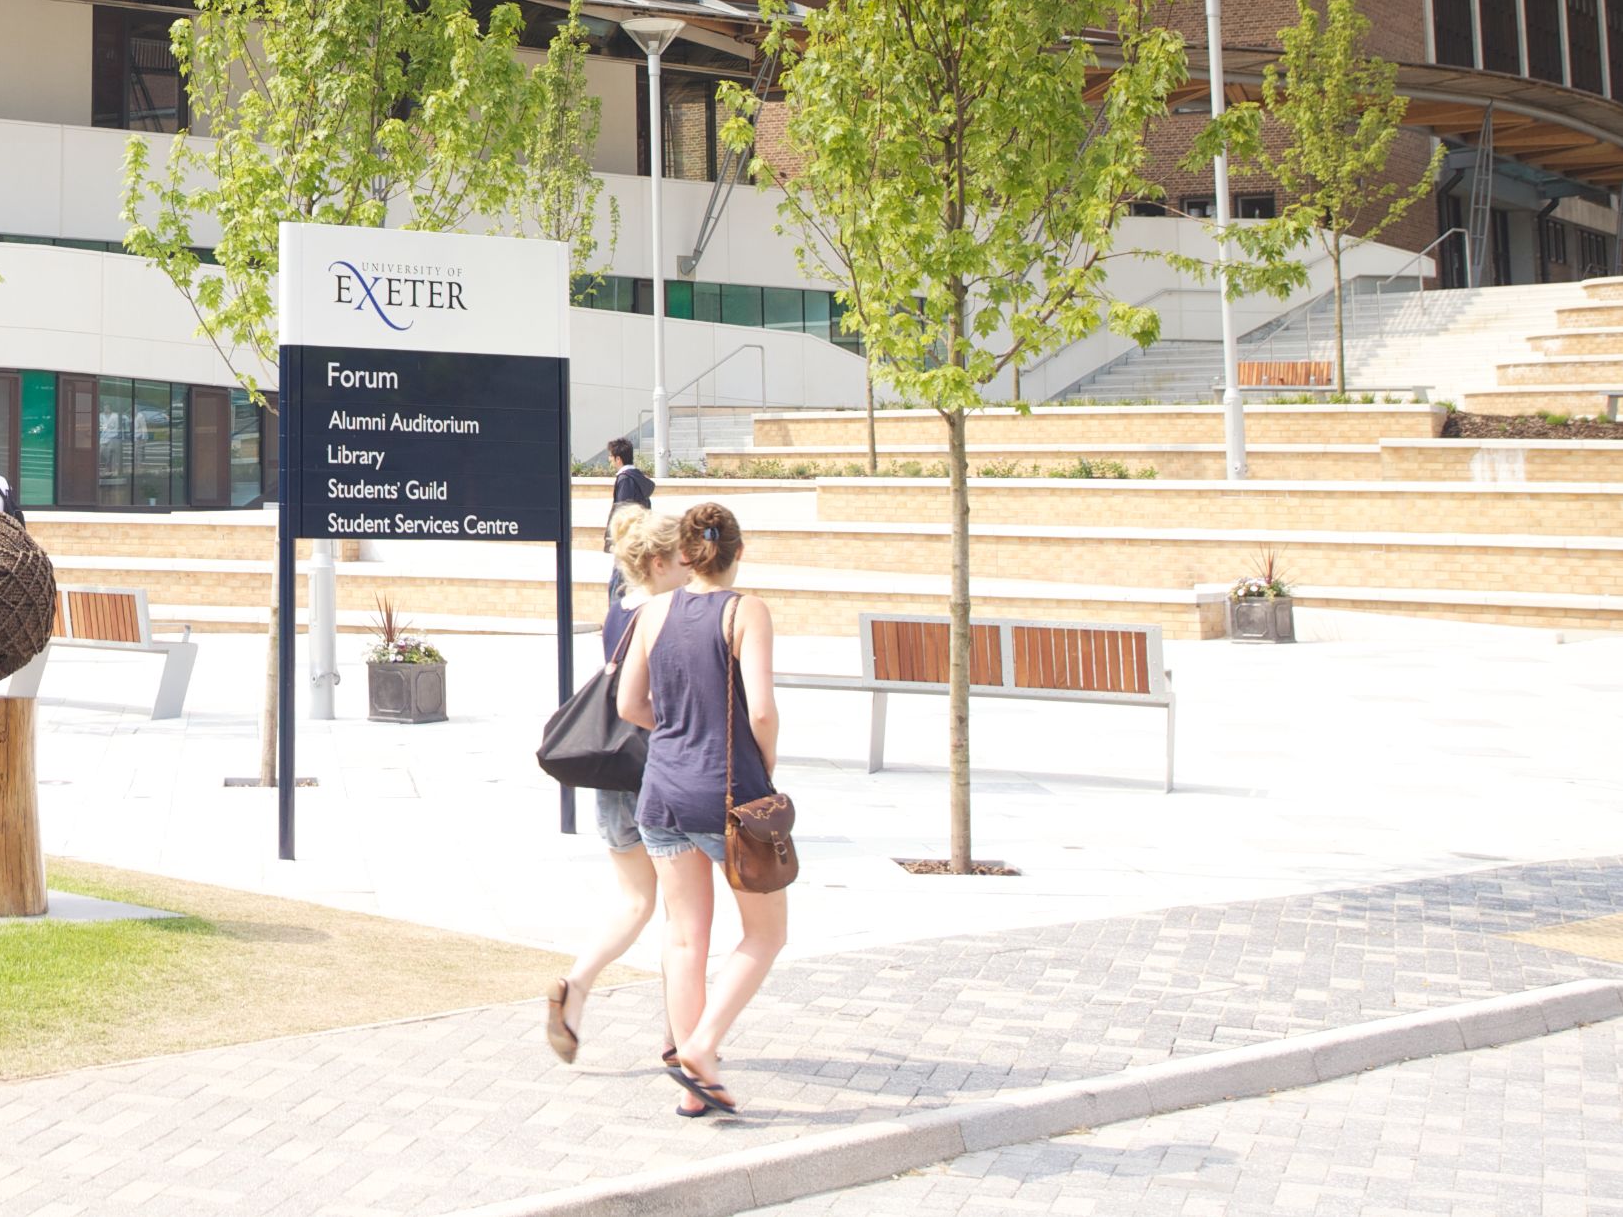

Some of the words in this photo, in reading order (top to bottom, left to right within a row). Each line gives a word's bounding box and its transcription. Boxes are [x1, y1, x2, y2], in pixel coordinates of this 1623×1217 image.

[362, 262, 441, 276] UNIVERSITY
[447, 267, 463, 277] OF
[328, 261, 468, 331] EXETER
[328, 362, 397, 389] Forum
[329, 411, 385, 431] Alumni
[390, 413, 479, 433] Auditorium
[328, 445, 385, 470] Library
[328, 479, 400, 499] Students'
[406, 480, 447, 500] Guild
[328, 513, 390, 533] Student
[395, 514, 459, 533] Services
[464, 515, 518, 534] Centre
